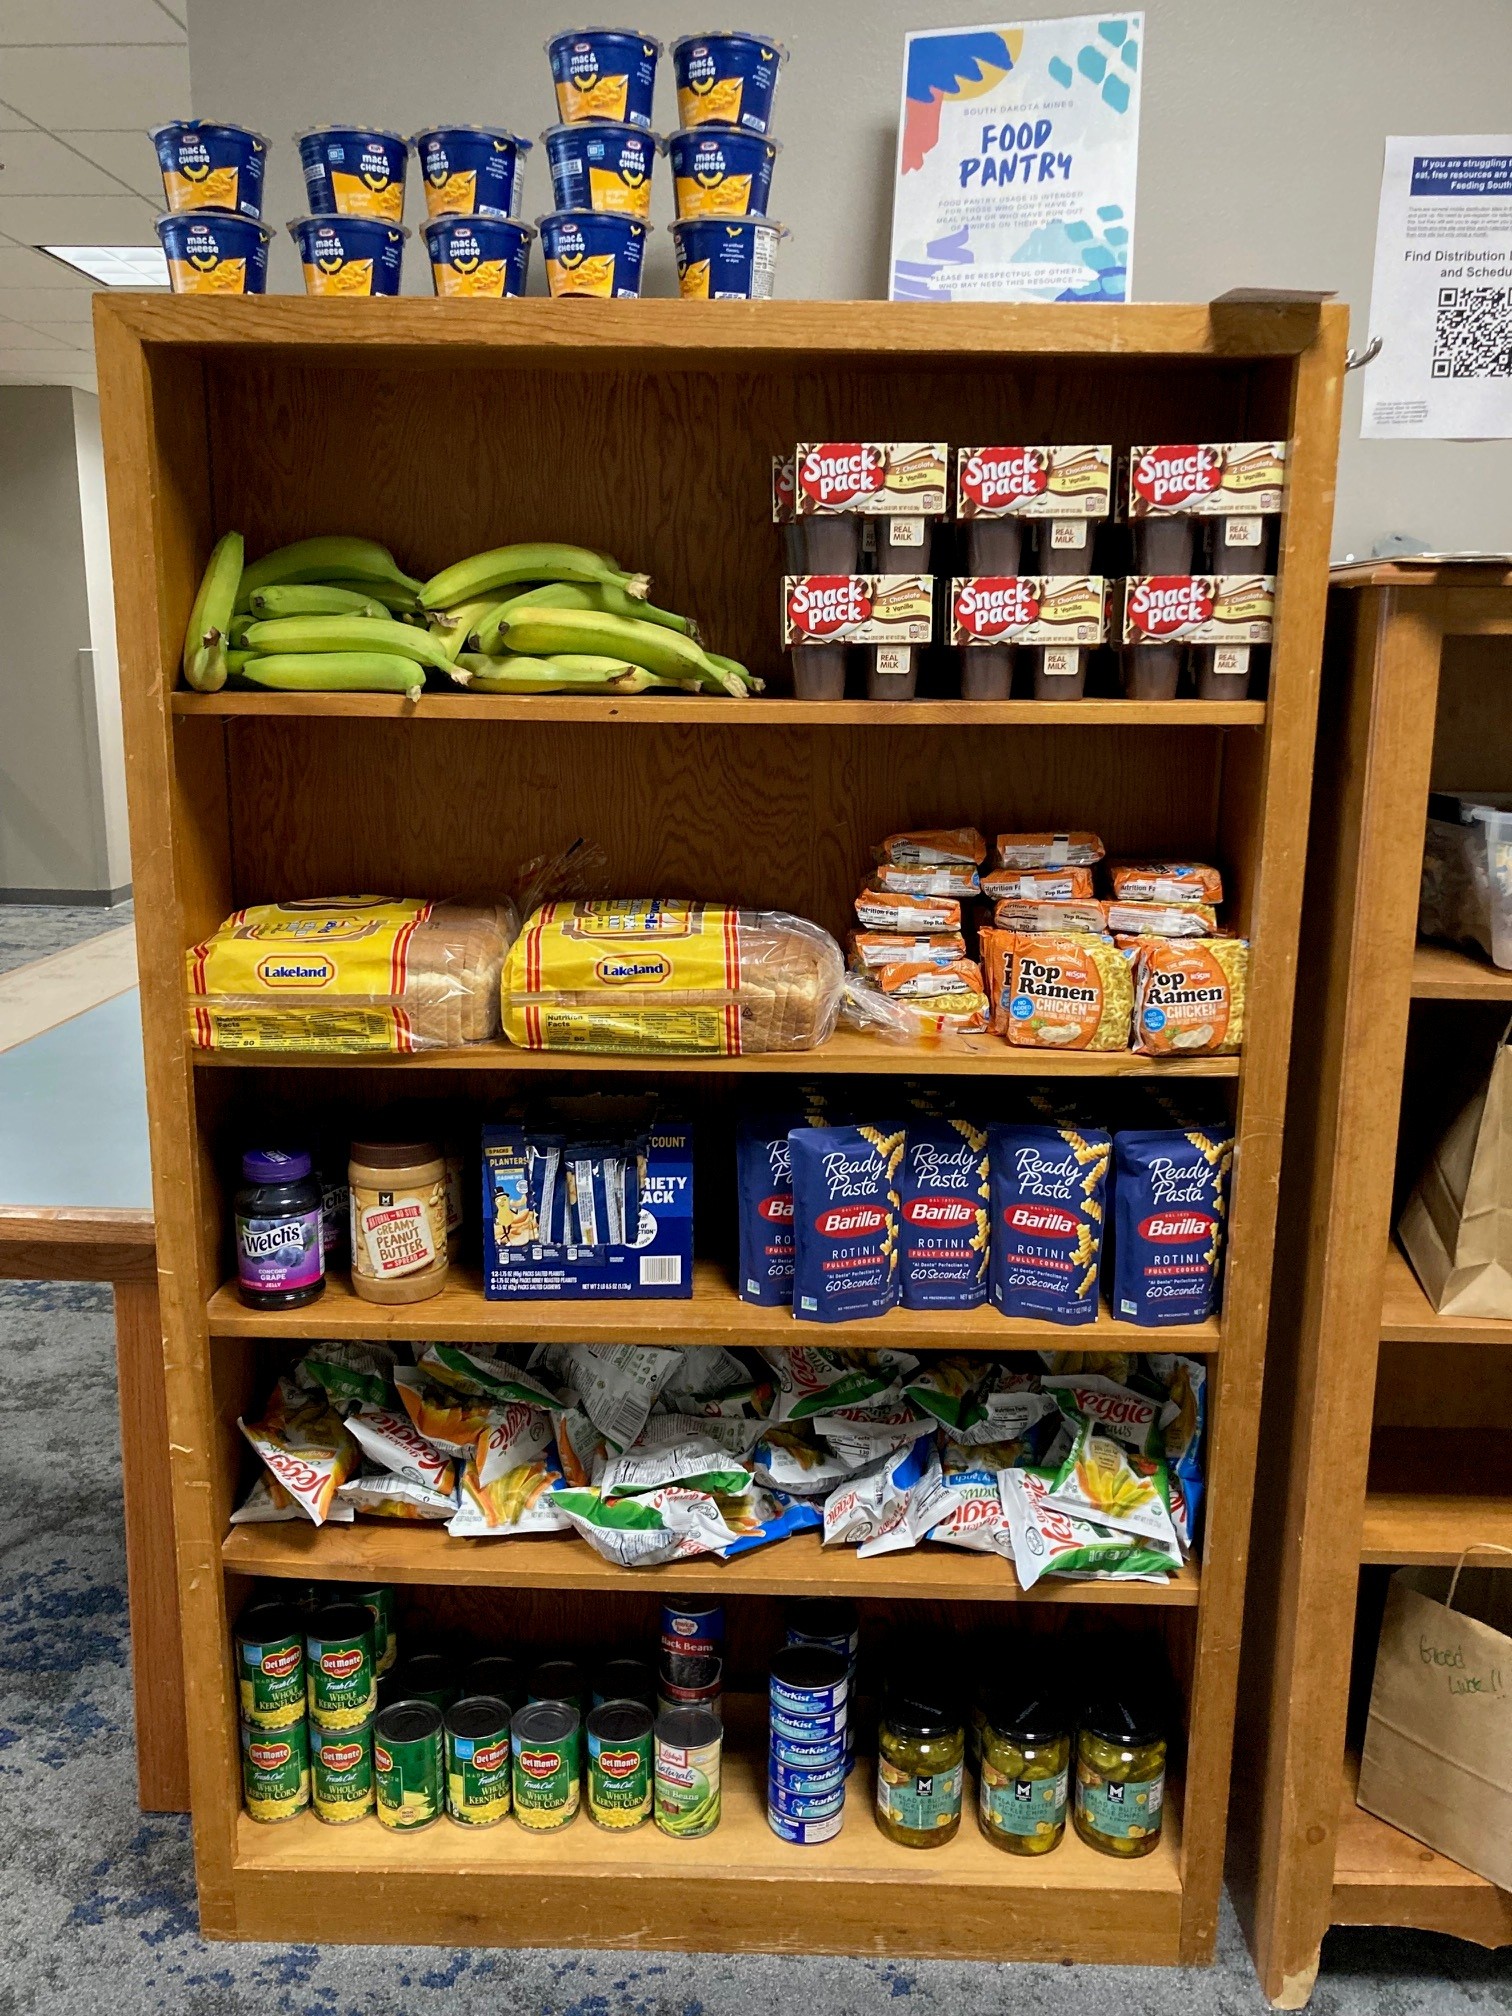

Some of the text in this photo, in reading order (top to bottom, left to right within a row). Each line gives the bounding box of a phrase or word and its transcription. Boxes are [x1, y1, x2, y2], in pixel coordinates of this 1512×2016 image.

[570, 52, 596, 65] mac &
[1000, 103, 1039, 113] DAKOTA
[1043, 100, 1074, 110] MINES
[981, 118, 1052, 154] FOOD
[179, 145, 207, 155] mac &
[362, 154, 388, 166] mac &
[1429, 160, 1445, 170] you
[1462, 159, 1507, 169] struggling
[959, 151, 1073, 188] PANTRY
[1432, 170, 1448, 179] free
[1450, 171, 1492, 179] resources
[1451, 181, 1486, 191] Feeding
[186, 235, 216, 245] mac &
[1405, 250, 1505, 262] Find Distribution
[931, 274, 962, 282] PLEASE
[977, 270, 1032, 279] RESPECTFUL
[1048, 267, 1083, 275] OTHERS
[1027, 277, 1073, 285] RESOURCE
[1440, 267, 1463, 278] and
[804, 448, 876, 483] Snack
[901, 460, 935, 473] Chocolate
[965, 448, 1039, 486] Snack
[1137, 448, 1212, 484] Snack
[819, 468, 876, 500] pack
[905, 471, 928, 482] Vanilla
[981, 471, 1038, 503] pack
[1153, 470, 1211, 502] pack
[893, 525, 912, 533] REAL
[893, 533, 912, 541] MILK
[792, 579, 864, 614] Snack
[959, 579, 1031, 615] Snack
[1132, 579, 1205, 613] Snack
[808, 599, 864, 631] pack
[975, 602, 1029, 632] pack
[1147, 601, 1203, 630] pack
[880, 654, 899, 662] REAL
[880, 661, 899, 669] MILK
[264, 965, 327, 979] Lakeland
[602, 962, 664, 978] Lakeland
[1020, 958, 1060, 983] Top
[1018, 977, 1096, 1002] Ramen
[1146, 987, 1223, 1004] Ramen
[1036, 997, 1087, 1015] CHICKEN
[1166, 1004, 1217, 1019] CHICKEN
[547, 1013, 583, 1022] Nutrition
[651, 1136, 686, 1148] COUNT
[489, 1156, 527, 1167] PLANTERS
[821, 1150, 886, 1181] Ready
[910, 1143, 978, 1172] Ready
[1014, 1147, 1083, 1185] Ready
[914, 1165, 969, 1189] Pasta
[1148, 1156, 1214, 1187] Ready
[826, 1175, 879, 1200] Pasta
[1018, 1171, 1072, 1200] Pasta
[1152, 1180, 1205, 1205] Pasta
[911, 1203, 970, 1220] Barilla
[376, 1219, 415, 1235] CREAMY
[824, 1211, 881, 1232] Barilla
[1012, 1208, 1073, 1233] Barilla
[1147, 1219, 1207, 1237] Barilla
[245, 1224, 300, 1253] Welch's
[376, 1230, 420, 1246] PEANUT
[918, 1238, 964, 1249] ROTINI
[379, 1240, 423, 1261] BUTTER
[832, 1247, 875, 1259] ROTINI
[1017, 1243, 1065, 1260] ROTINI
[393, 1255, 419, 1267] SPREAD
[826, 1256, 881, 1269] FULLY COOKED
[1154, 1254, 1199, 1265] ROTINI
[260, 1273, 287, 1281] GRAPE
[825, 1274, 882, 1292] 60 Seconds!
[1074, 1387, 1154, 1425] Veggie
[370, 1414, 450, 1485] Veggie
[683, 1642, 713, 1652] Beans
[323, 1655, 360, 1669] Del Monte
[318, 1693, 368, 1709] KERNEL CORN
[330, 1690, 357, 1702] WHOLE
[776, 1685, 811, 1702] StarKist
[777, 1712, 813, 1729] StarKist
[790, 1743, 828, 1756] StarKist
[602, 1757, 638, 1767] Del Monte
[656, 1759, 696, 1781] Naturals
